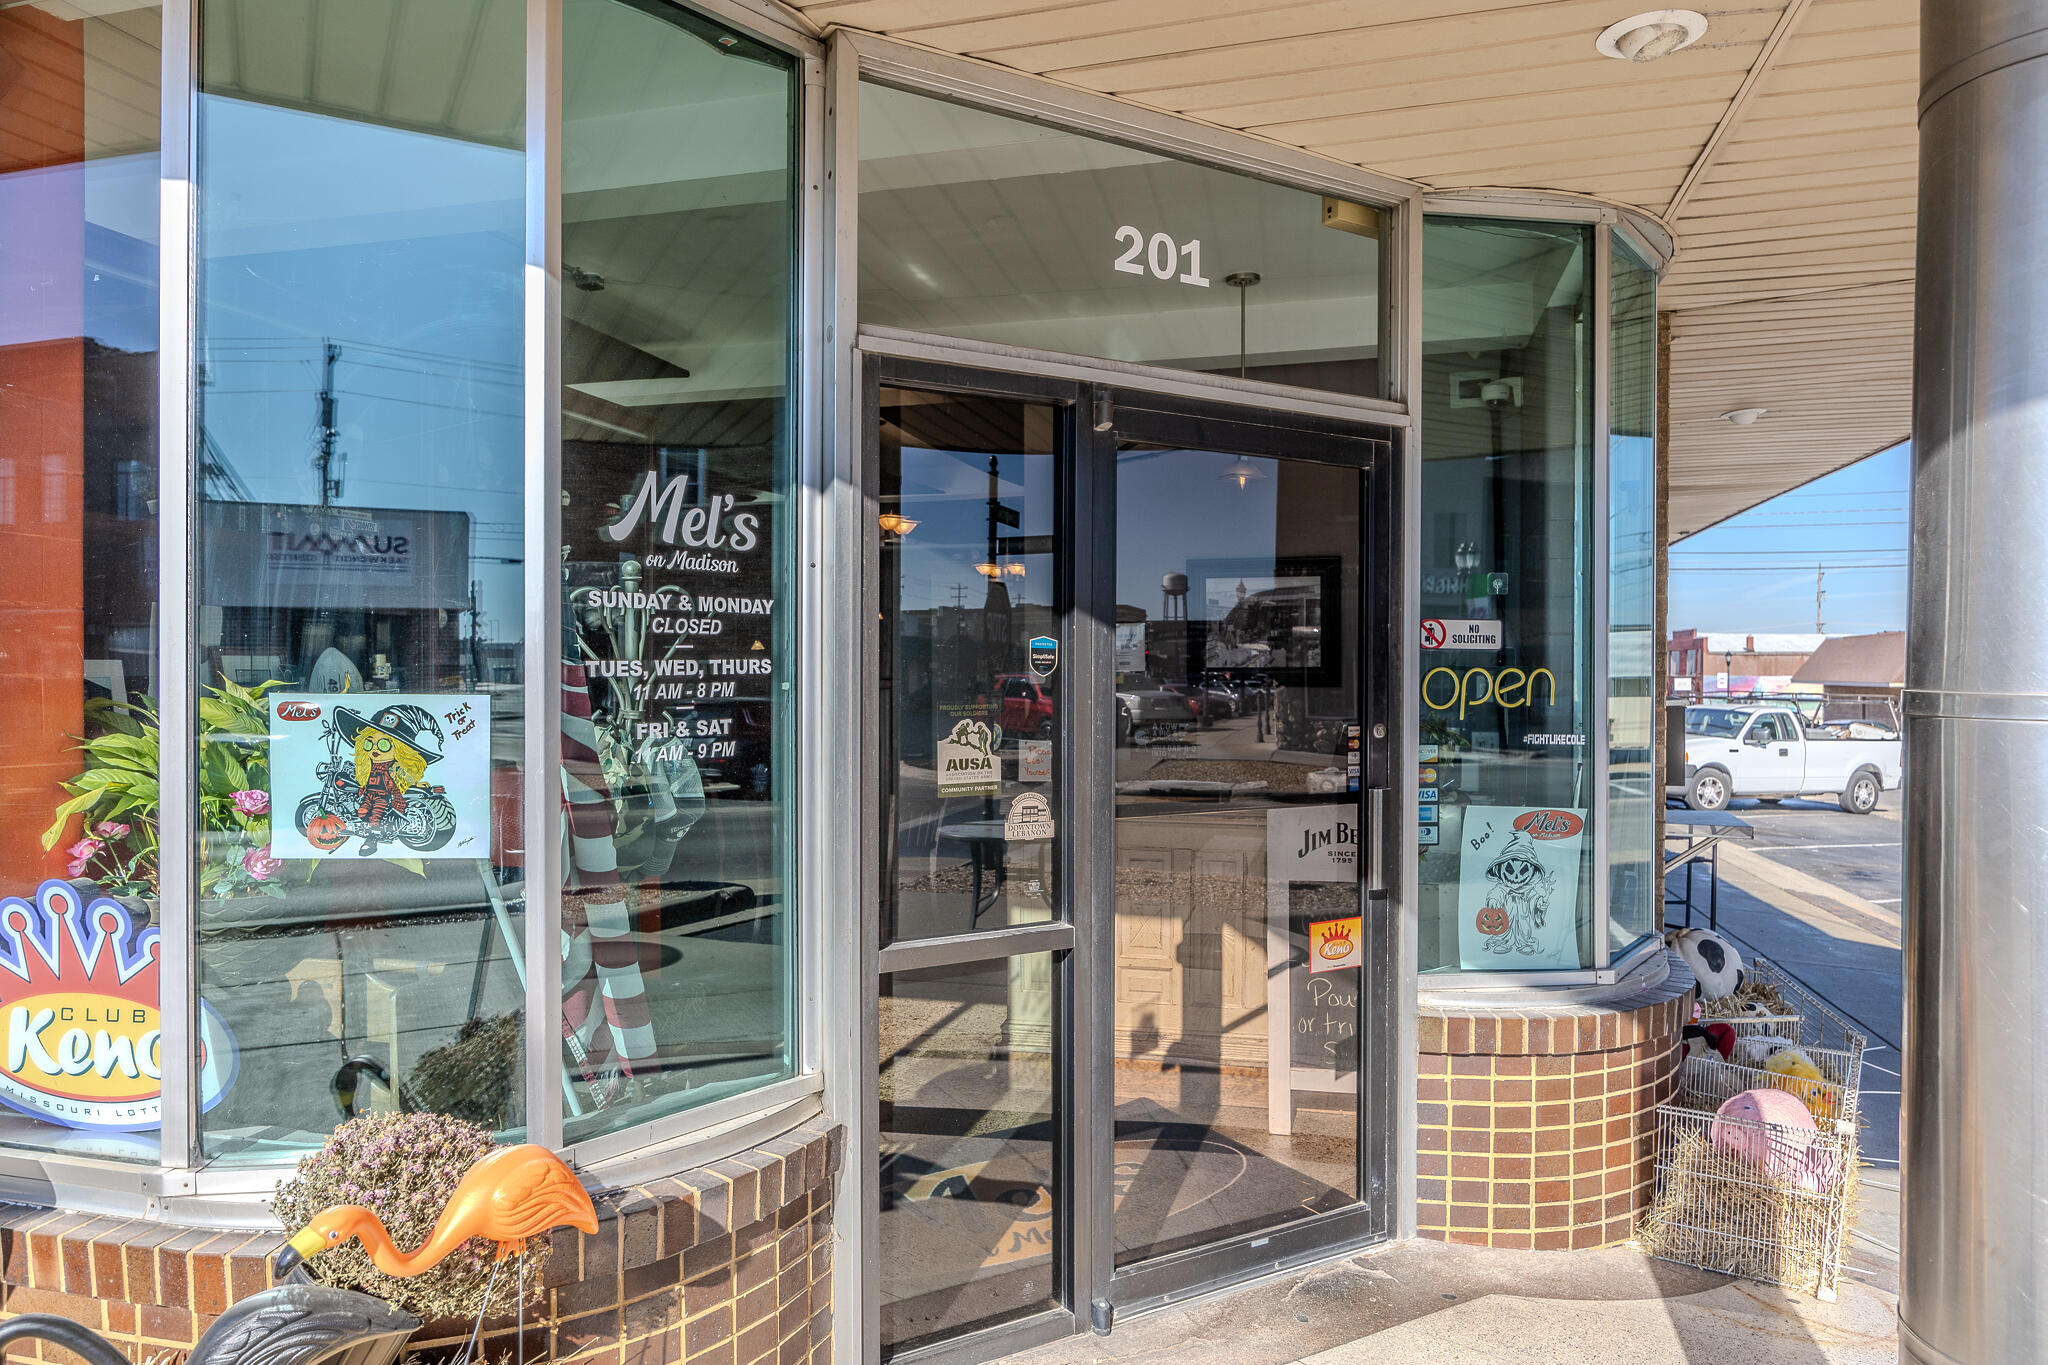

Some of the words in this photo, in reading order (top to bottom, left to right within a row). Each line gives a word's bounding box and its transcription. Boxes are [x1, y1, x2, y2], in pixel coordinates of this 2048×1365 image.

[1114, 224, 1210, 288] 201
[608, 470, 759, 552] Mel's
[646, 554, 666, 567] on
[667, 550, 739, 574] Madison
[588, 590, 672, 610] SUNDAY
[678, 596, 692, 611] &
[698, 596, 774, 614] MONDAY
[652, 618, 722, 635] CLOSED
[1468, 624, 1480, 634] NO
[1452, 634, 1496, 644] SOLICITING
[586, 660, 649, 680] TUES,
[655, 660, 704, 678] WED,
[709, 658, 772, 675] THURS
[634, 684, 651, 700] 11
[654, 683, 683, 700] AM
[697, 682, 706, 698] 8
[710, 682, 736, 698] PM
[1422, 666, 1556, 720] open
[444, 702, 472, 724] Trick
[458, 716, 466, 725] or
[451, 719, 476, 741] Treat
[636, 722, 668, 740] FRI
[676, 721, 690, 738] &
[696, 718, 732, 736] SAT
[656, 744, 684, 762] AM
[698, 743, 706, 759] 9
[711, 741, 736, 758] PM
[946, 758, 992, 772] AUSA
[1008, 823, 1052, 832] DOWNTOWN
[1522, 811, 1570, 832] Mel's
[1298, 828, 1332, 858] JIM
[1470, 822, 1494, 850] Boo!
[1324, 944, 1350, 956] Keno
[61, 1007, 146, 1023] CLUB
[5, 1085, 100, 1116] MISSOURI
[116, 1106, 160, 1117] LOTT
